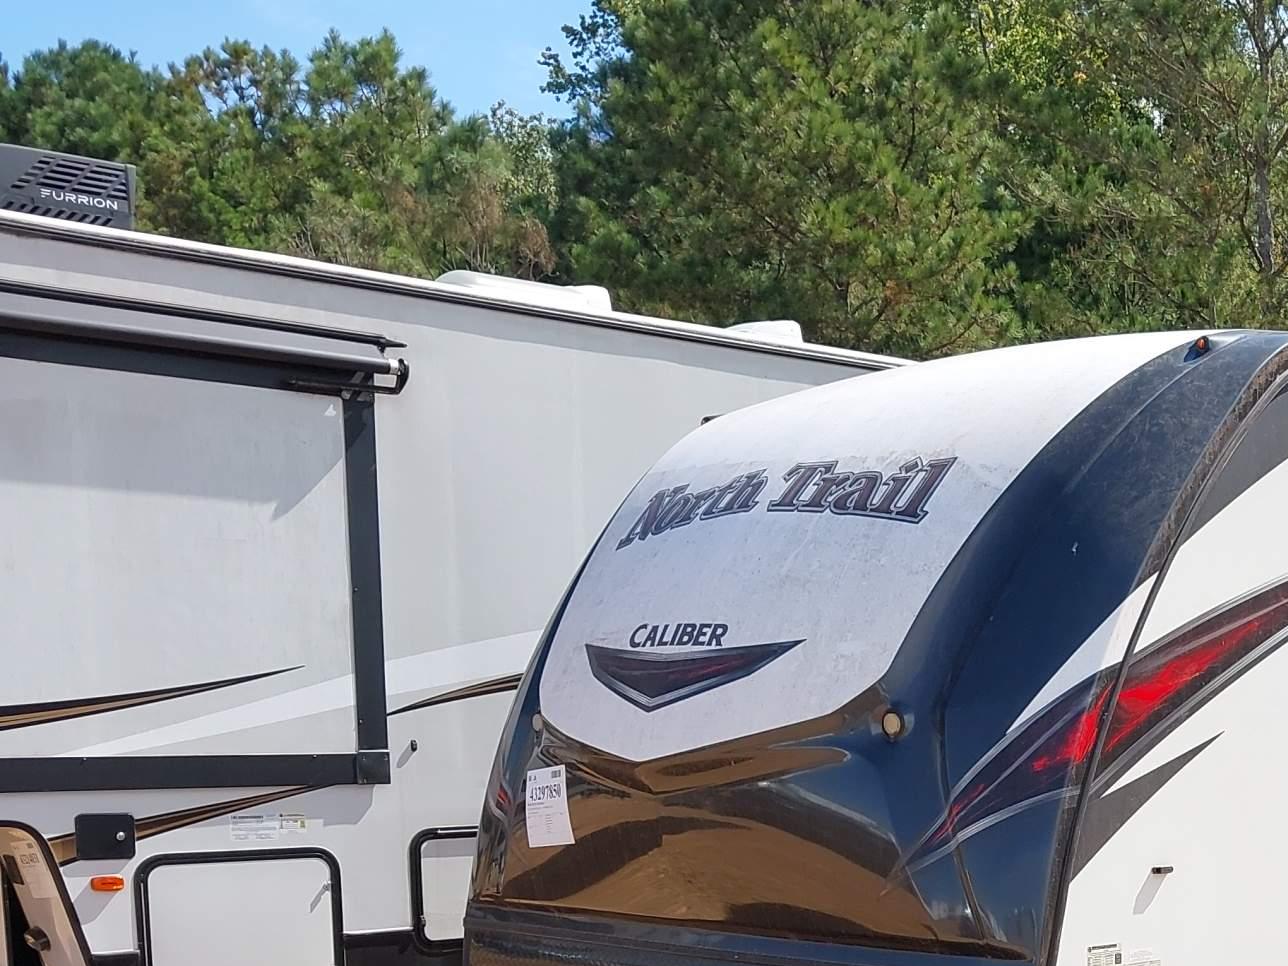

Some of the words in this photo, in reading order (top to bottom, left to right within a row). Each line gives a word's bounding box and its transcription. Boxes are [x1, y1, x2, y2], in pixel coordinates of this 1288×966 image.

[40, 188, 118, 210] FURRION
[615, 467, 768, 551] North
[766, 455, 959, 525] Trail
[628, 622, 729, 649] CALIBER
[529, 783, 562, 801] 43297850
